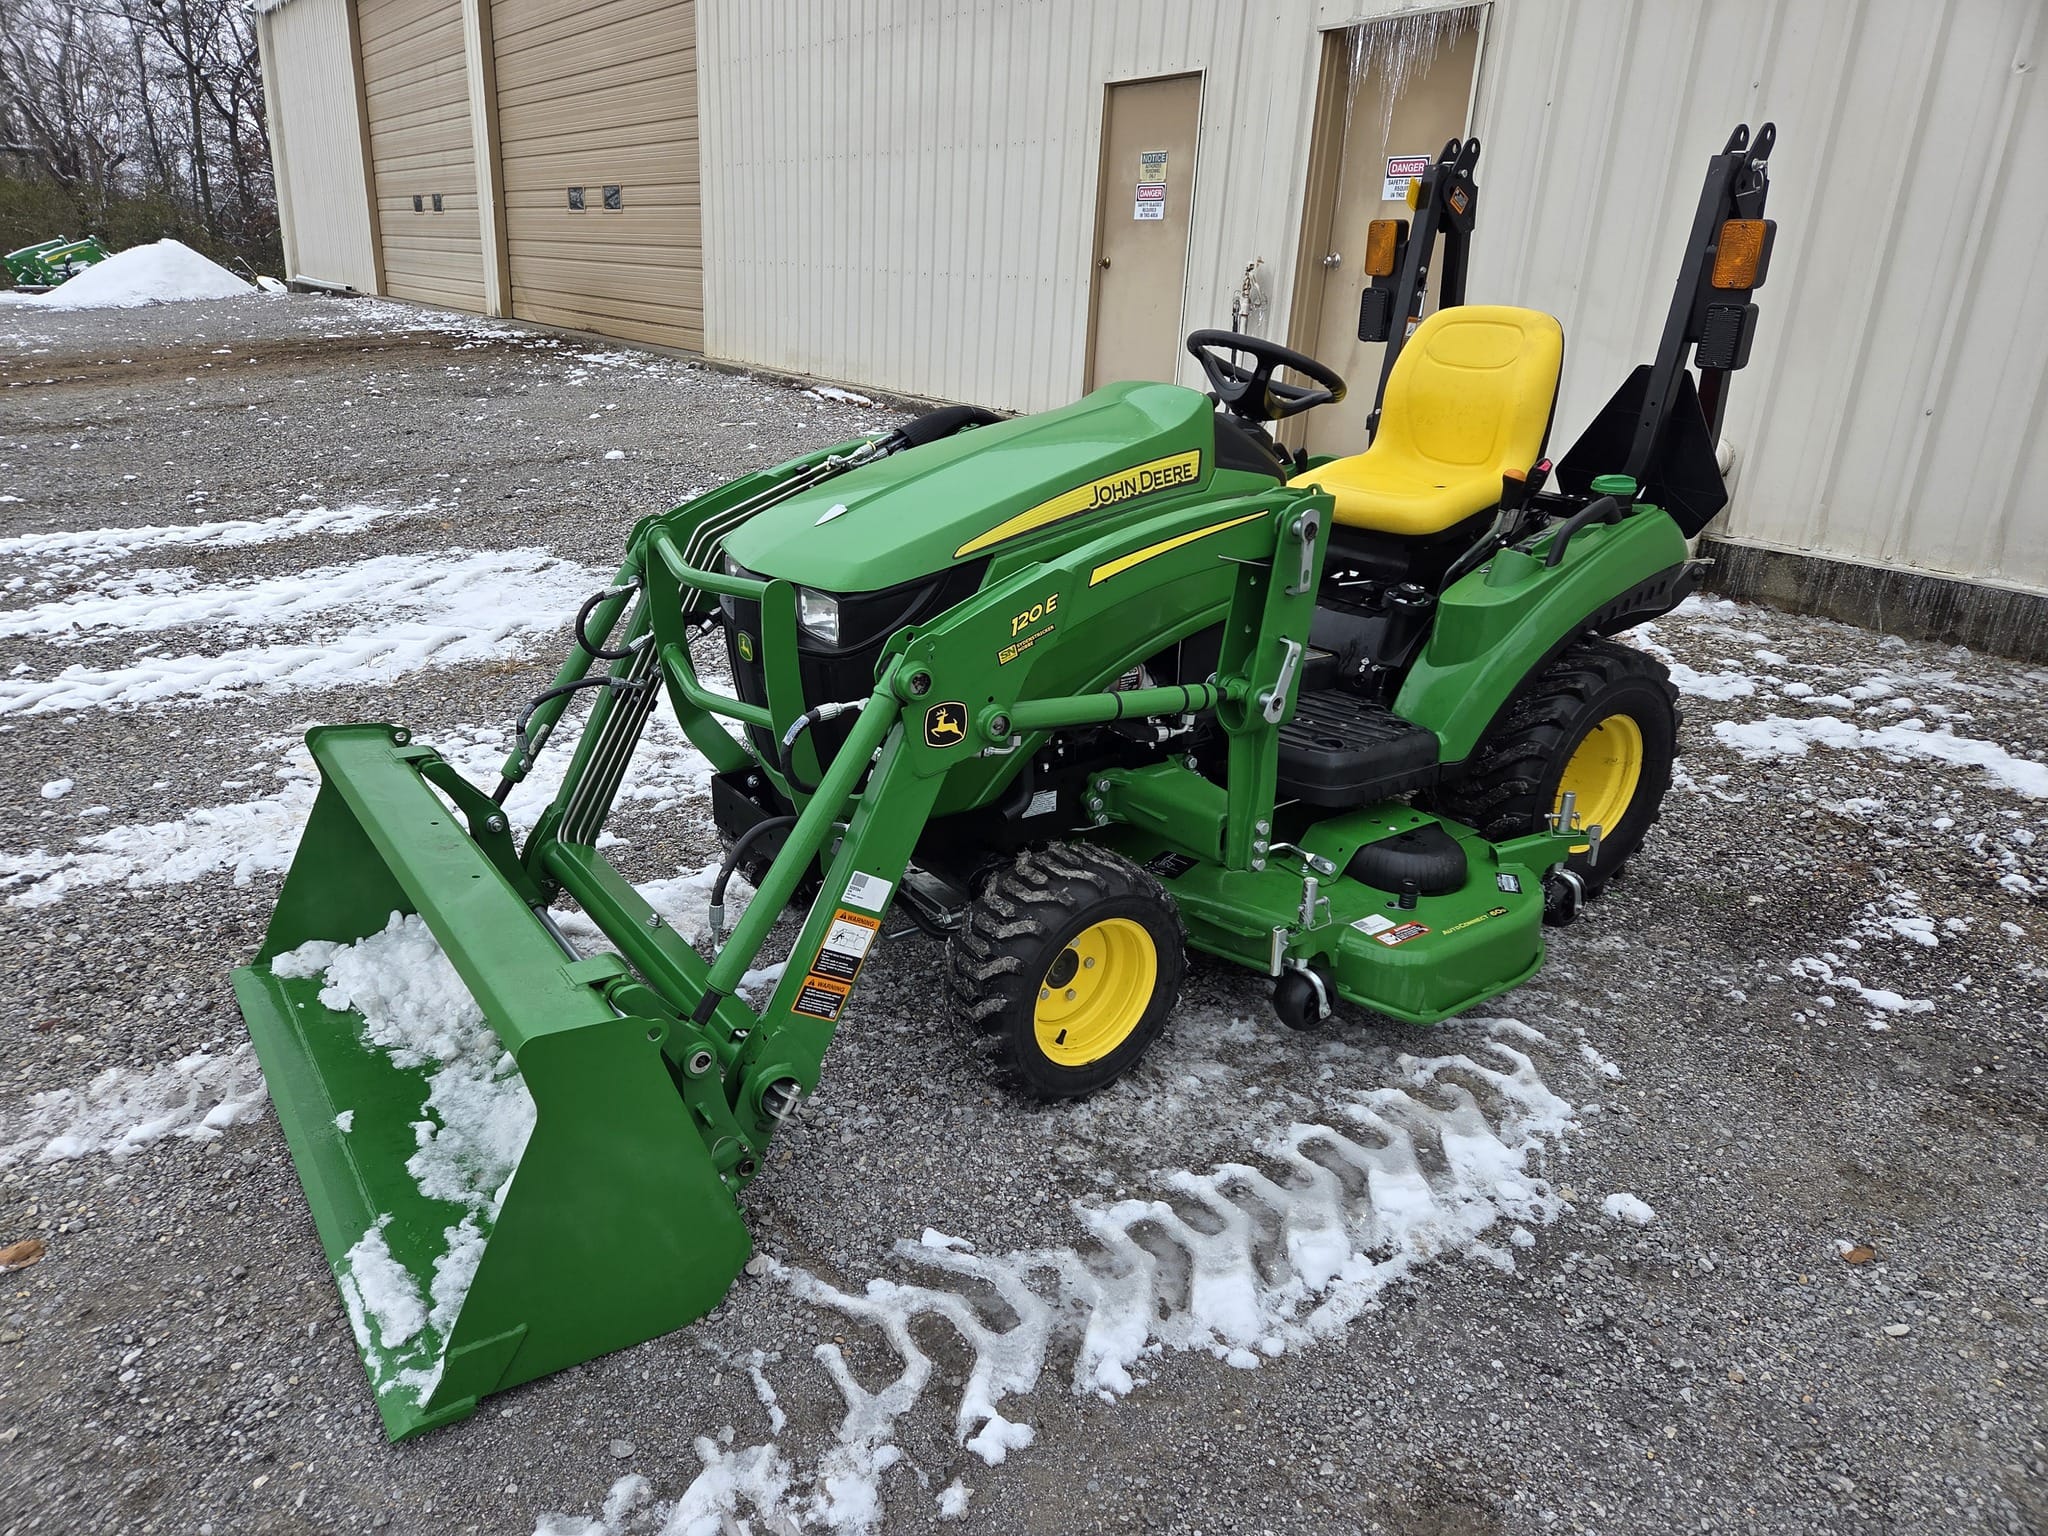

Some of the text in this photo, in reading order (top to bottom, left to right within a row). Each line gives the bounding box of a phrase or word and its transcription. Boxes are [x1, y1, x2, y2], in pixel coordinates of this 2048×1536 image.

[1142, 153, 1166, 163] NOTICE
[1391, 162, 1425, 173] DANGER
[1139, 189, 1162, 198] DANGER
[1089, 463, 1193, 507] JOHN DEERE
[1011, 593, 1059, 637] 120 E
[1000, 646, 1016, 660] SN
[847, 914, 875, 927] WARNING
[817, 982, 845, 993] WARNING
